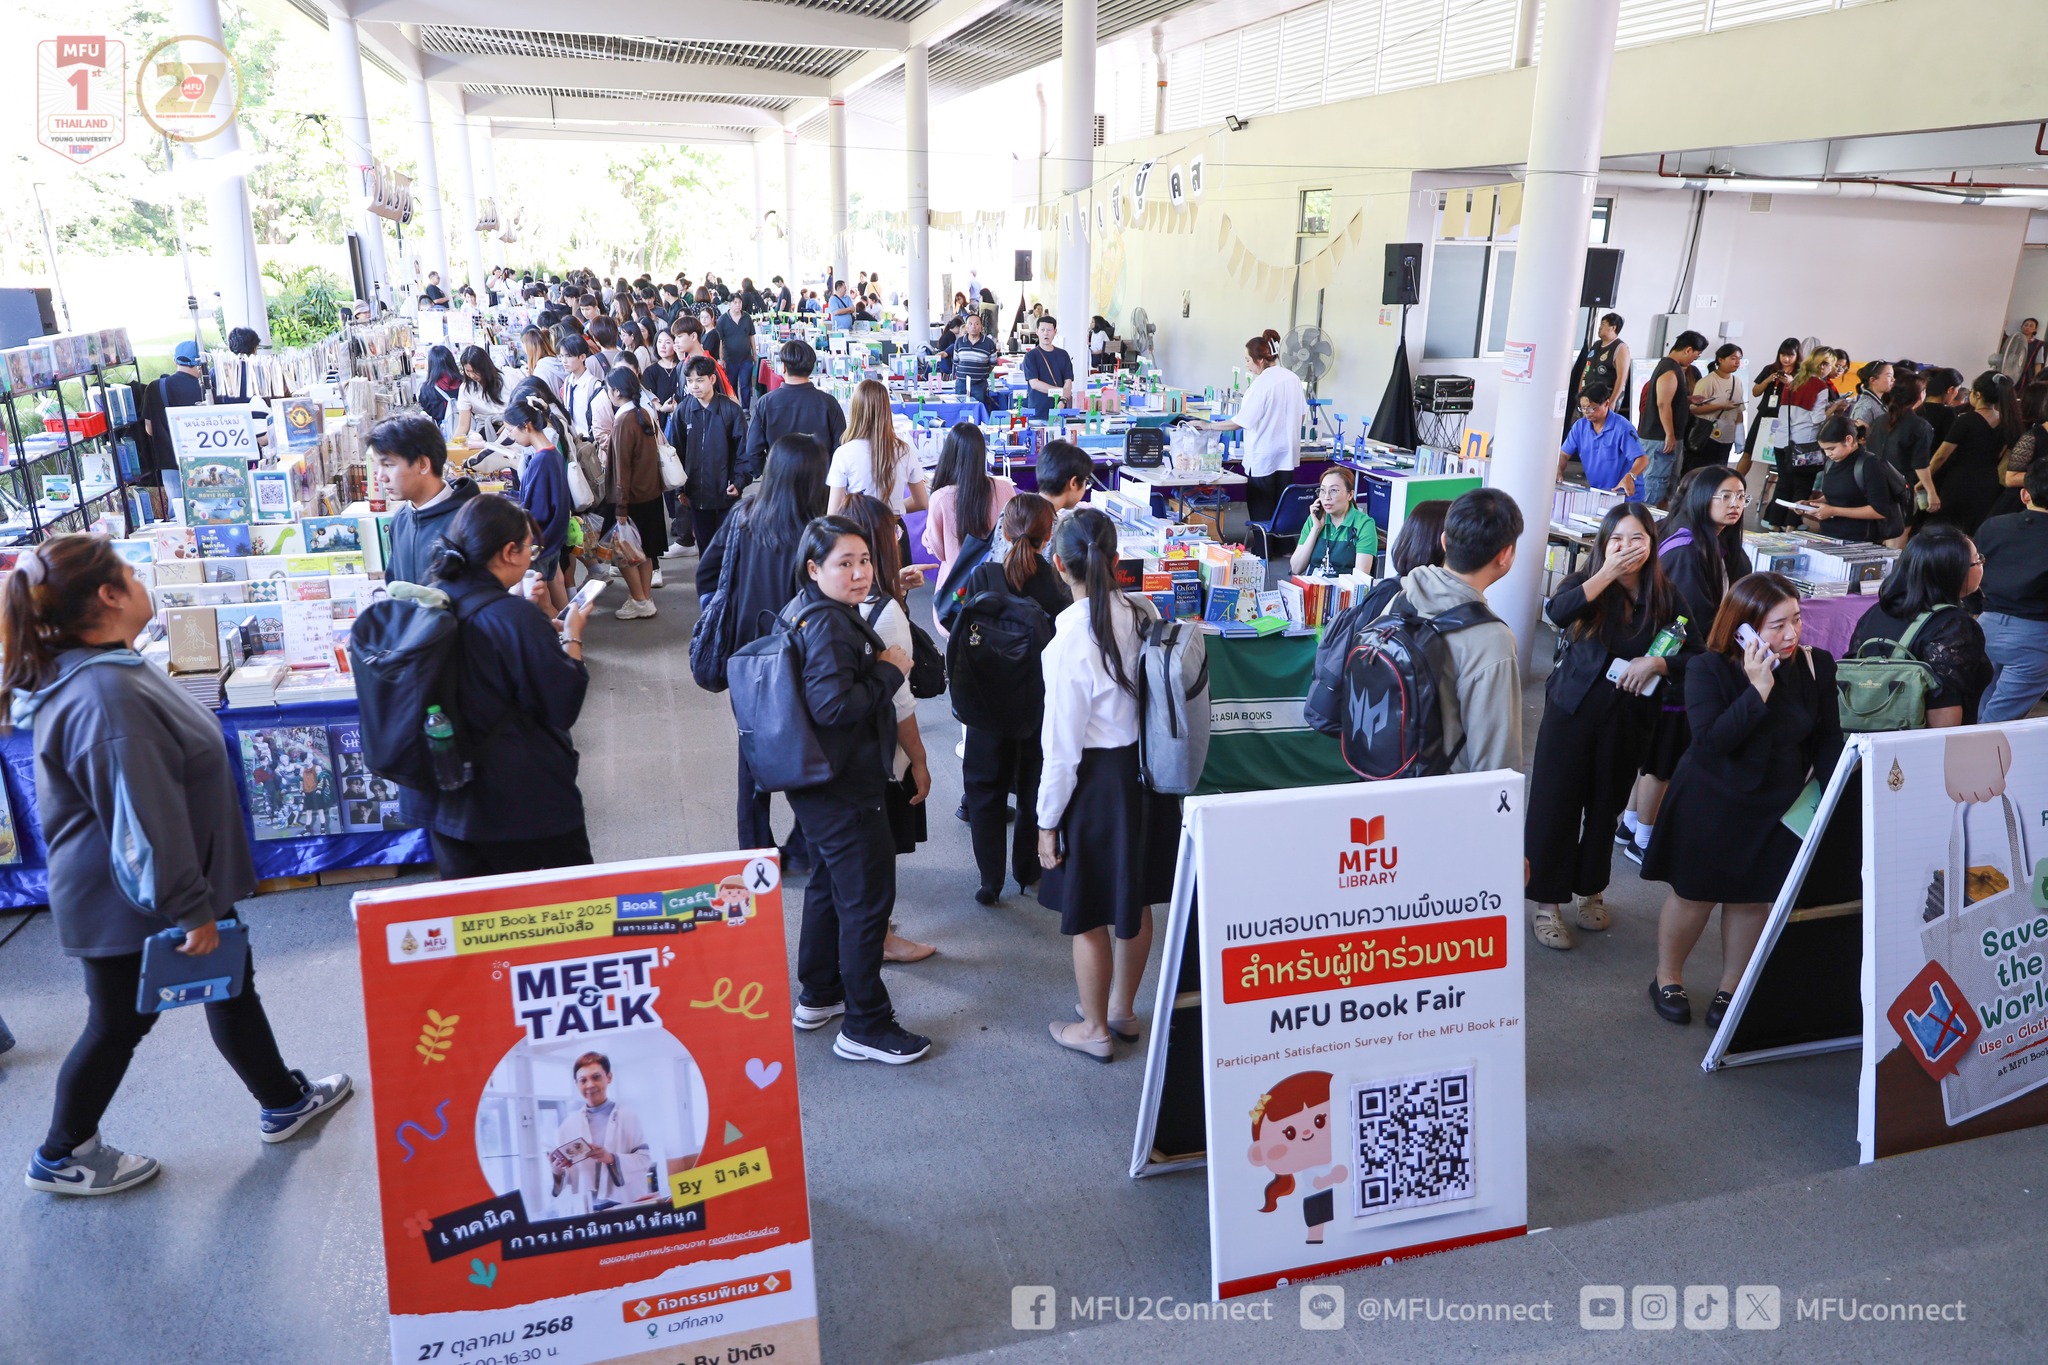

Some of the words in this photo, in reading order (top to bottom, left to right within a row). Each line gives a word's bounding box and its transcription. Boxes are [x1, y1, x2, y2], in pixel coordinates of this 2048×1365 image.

[183, 414, 240, 428] หนังสือใหม่
[196, 428, 249, 449] 20%
[1220, 712, 1240, 721] ASIA
[1241, 711, 1272, 721] BOOKS
[1338, 846, 1398, 874] MFU
[1338, 870, 1398, 889] LIBRARY
[622, 898, 658, 912] Book
[668, 890, 712, 909] Craft
[461, 917, 495, 933] MFU
[500, 912, 537, 928] Book
[541, 907, 573, 924] Fair
[577, 903, 612, 918] 2025
[1226, 890, 1502, 941] แบบสอบถามความพึงพอใจ
[424, 937, 447, 948] MFU
[463, 919, 594, 946] งานมหกรรมหนังสือ
[1982, 917, 2048, 957] Save
[1241, 935, 1495, 989] สำหรับผู้เข้าร่วมงาน
[1997, 955, 2043, 987] the
[517, 953, 653, 1001] MEET
[578, 985, 602, 1007] &
[1270, 1002, 1331, 1034] MFU
[1340, 994, 1408, 1023] Book
[1416, 985, 1466, 1012] Fair
[1980, 980, 2048, 1029] Worl
[521, 992, 655, 1040] TALK
[1216, 1050, 1280, 1069] Participant
[1284, 1040, 1351, 1059] Satisfaction
[1355, 1034, 1393, 1050] Survey
[1397, 1030, 1414, 1042] for
[1418, 1027, 1437, 1039] the
[1440, 1023, 1464, 1036] MFU
[1467, 1019, 1496, 1033] Book
[1499, 1016, 1519, 1028] Fair
[1979, 1038, 2002, 1055] Use
[2006, 1033, 2014, 1045] a
[1997, 1064, 2008, 1077] at
[2008, 1056, 2029, 1072] MFU
[678, 1179, 702, 1196] By
[440, 1208, 516, 1245] เทคนิค
[708, 1225, 780, 1246] readthecloud.co
[657, 1281, 759, 1312] กิจกรรมพิเศษ
[667, 1312, 724, 1333] เวทีกลาง
[418, 1341, 444, 1361] 27
[450, 1329, 515, 1358] ตุลาคม
[521, 1315, 574, 1340] 2568
[547, 1345, 560, 1358] น.
